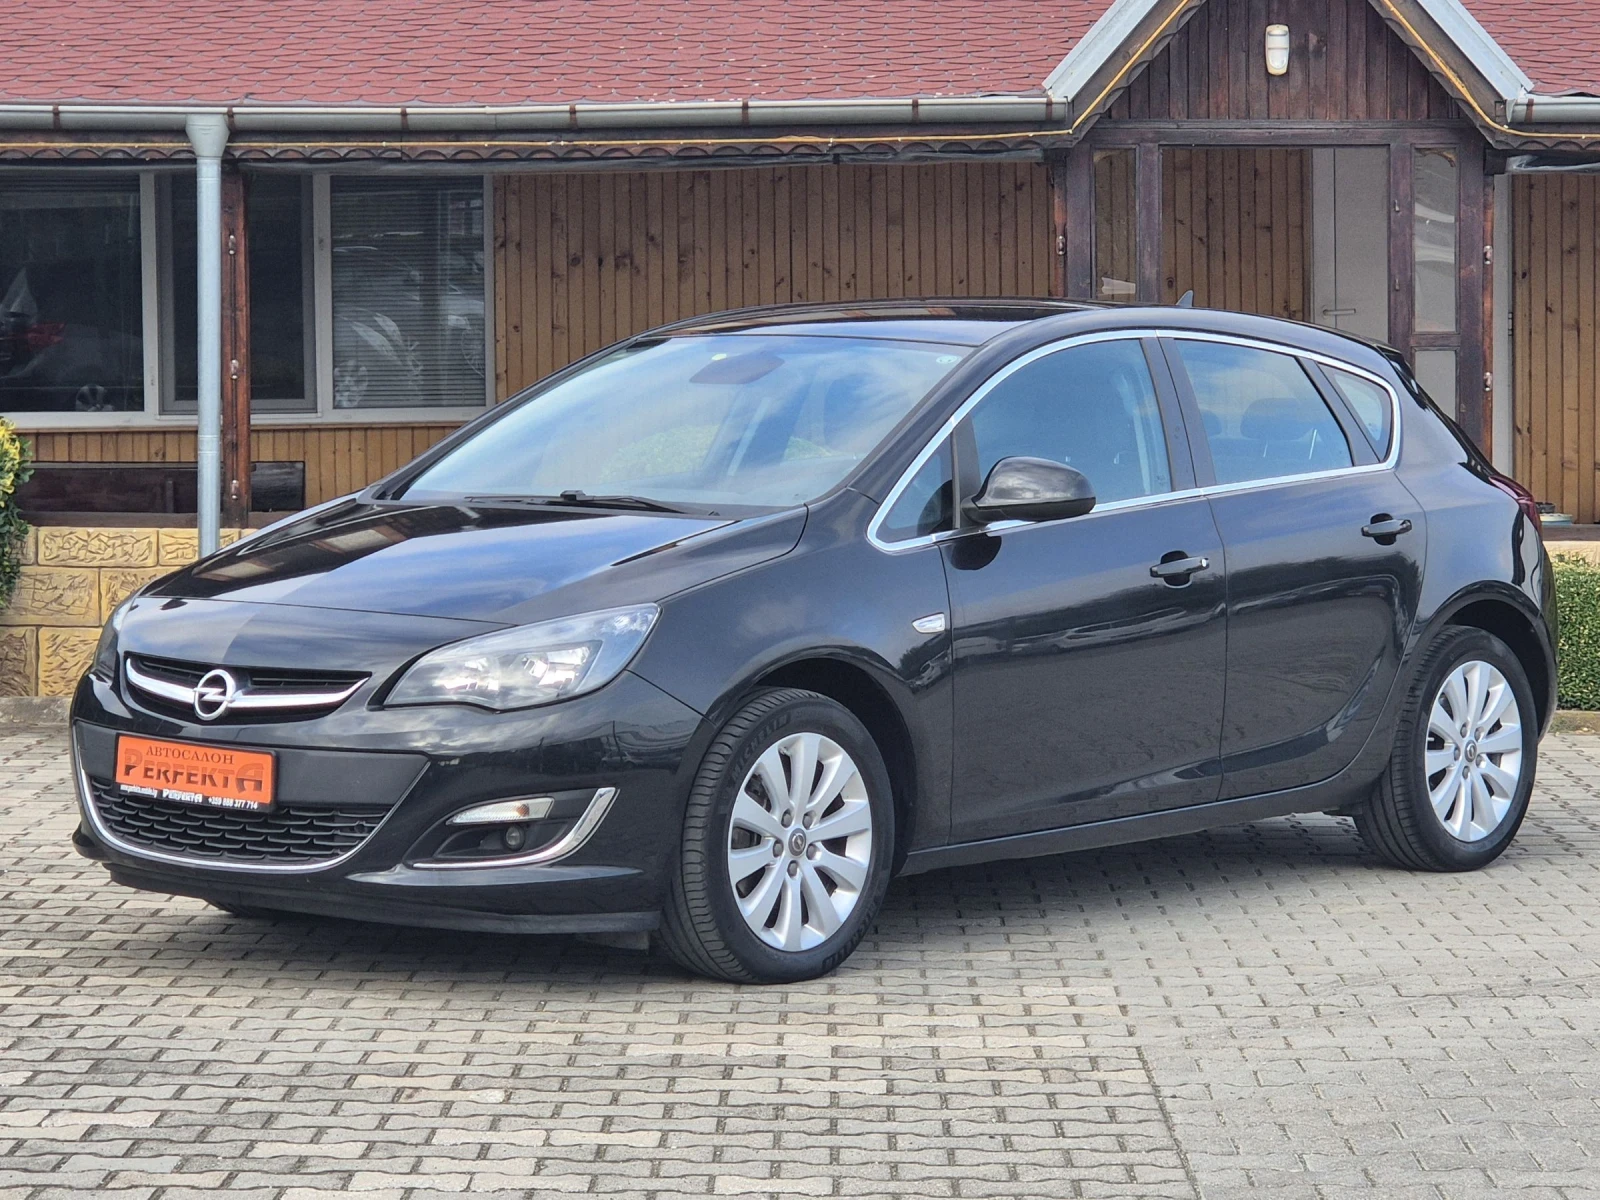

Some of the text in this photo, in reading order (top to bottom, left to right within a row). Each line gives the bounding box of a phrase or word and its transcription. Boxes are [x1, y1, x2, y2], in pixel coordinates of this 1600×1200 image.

[146, 745, 234, 764] АВТОСАЛОН
[123, 748, 265, 794] PERFEKTA
[246, 799, 258, 810] 714
